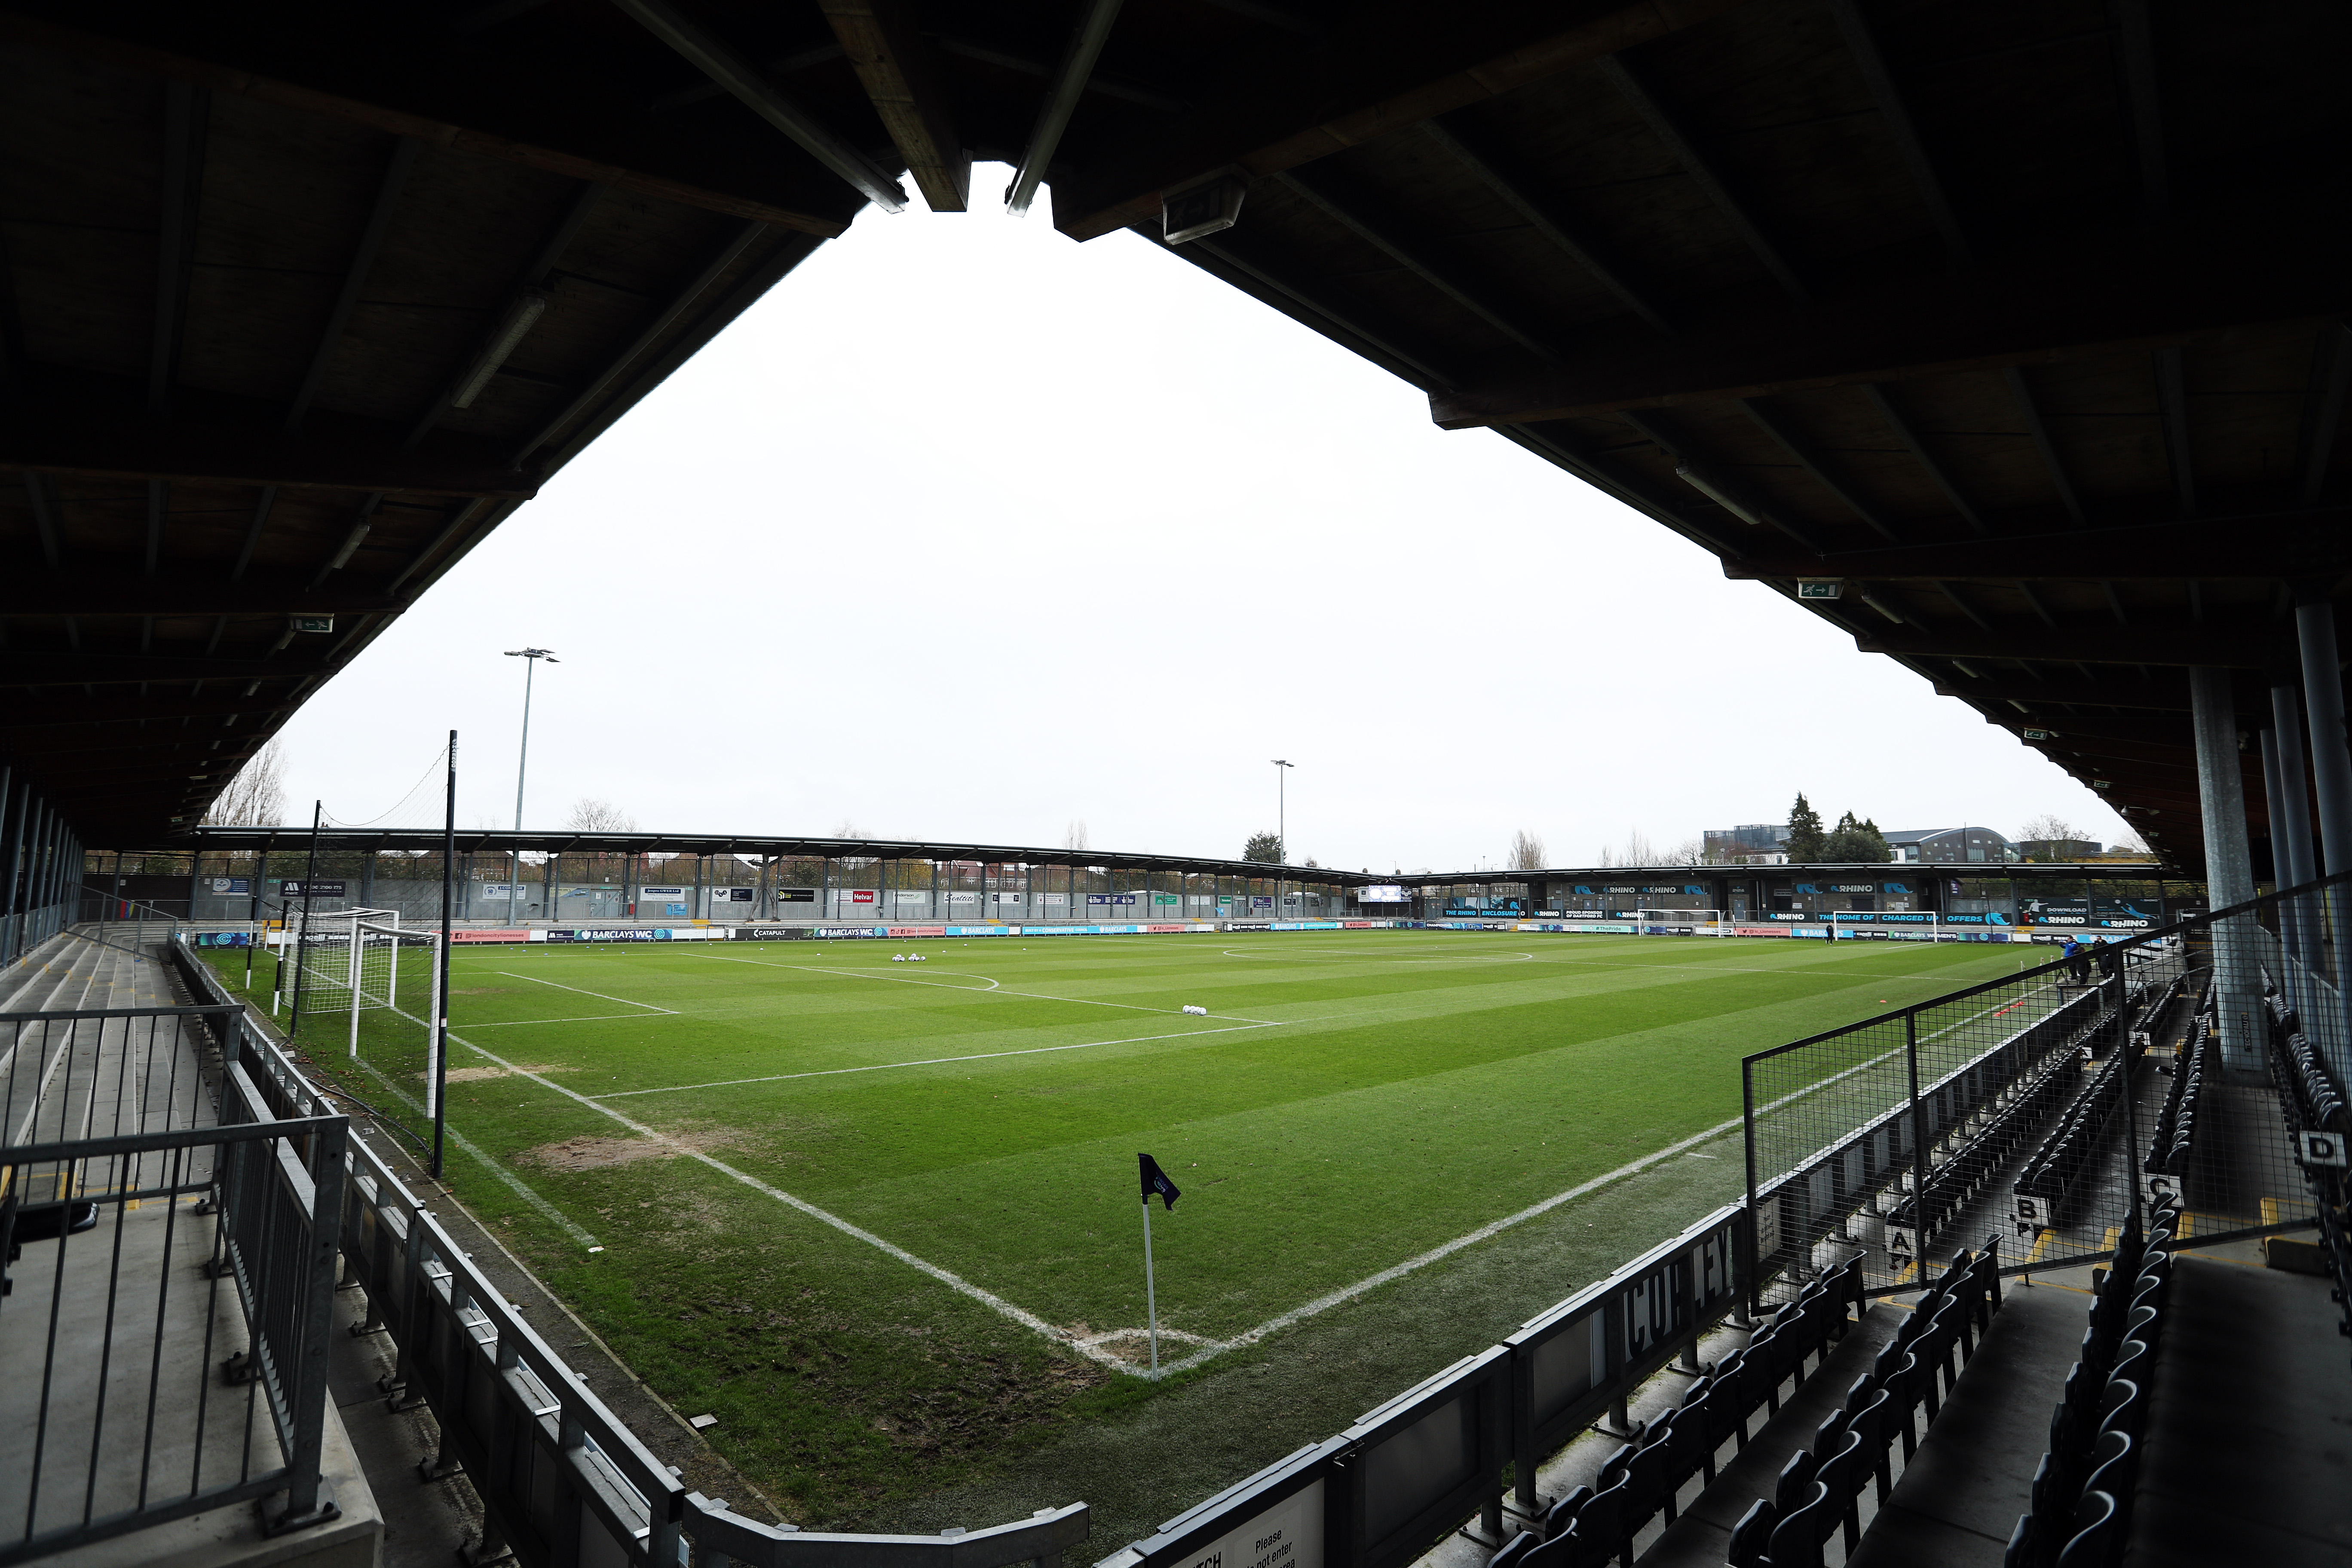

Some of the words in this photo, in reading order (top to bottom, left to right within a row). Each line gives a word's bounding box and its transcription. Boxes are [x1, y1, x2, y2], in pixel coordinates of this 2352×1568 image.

[592, 931, 634, 939] BARCLAYS
[635, 931, 652, 939] WC
[2309, 1136, 2334, 1158] D
[2017, 1199, 2037, 1218] B
[1891, 1231, 1910, 1250] A
[1255, 1529, 1282, 1554] Please
[1256, 1553, 1270, 1568] not
[1271, 1541, 1292, 1562] enter
[1279, 1558, 1295, 1568] rea
